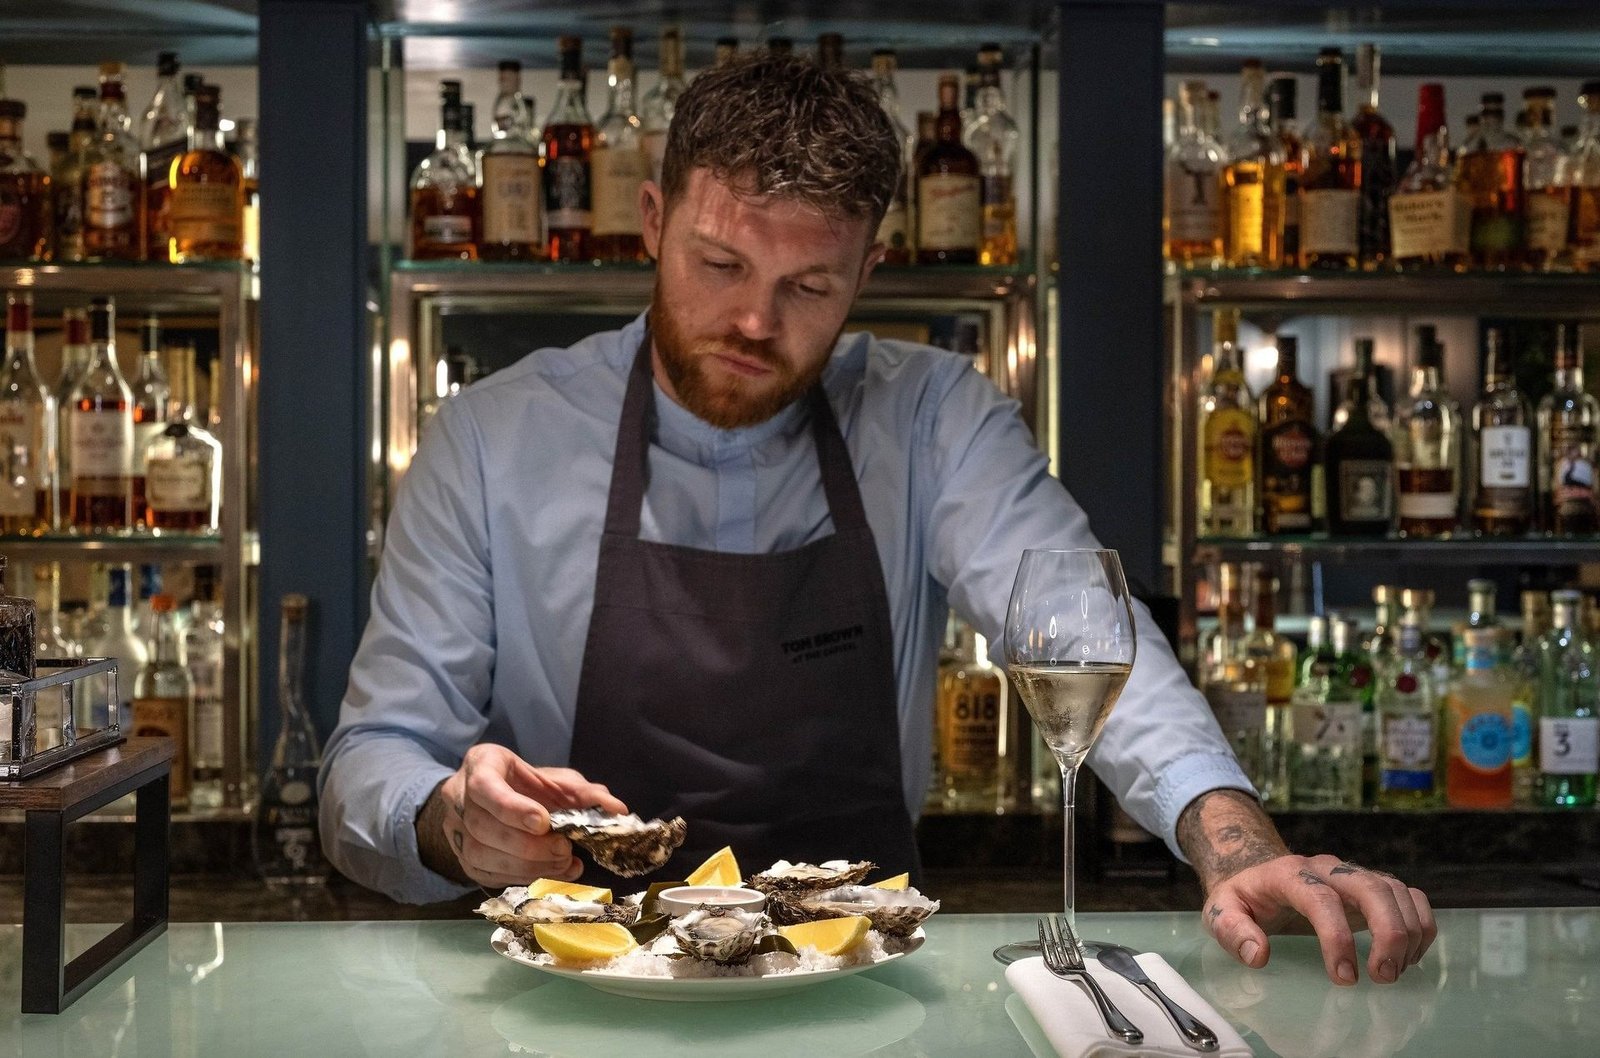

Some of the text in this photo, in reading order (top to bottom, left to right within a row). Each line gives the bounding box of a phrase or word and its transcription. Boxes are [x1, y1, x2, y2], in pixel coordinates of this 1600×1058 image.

[781, 624, 863, 654] TOM BROWN
[955, 693, 998, 720] 818
[1554, 731, 1571, 757] 3
